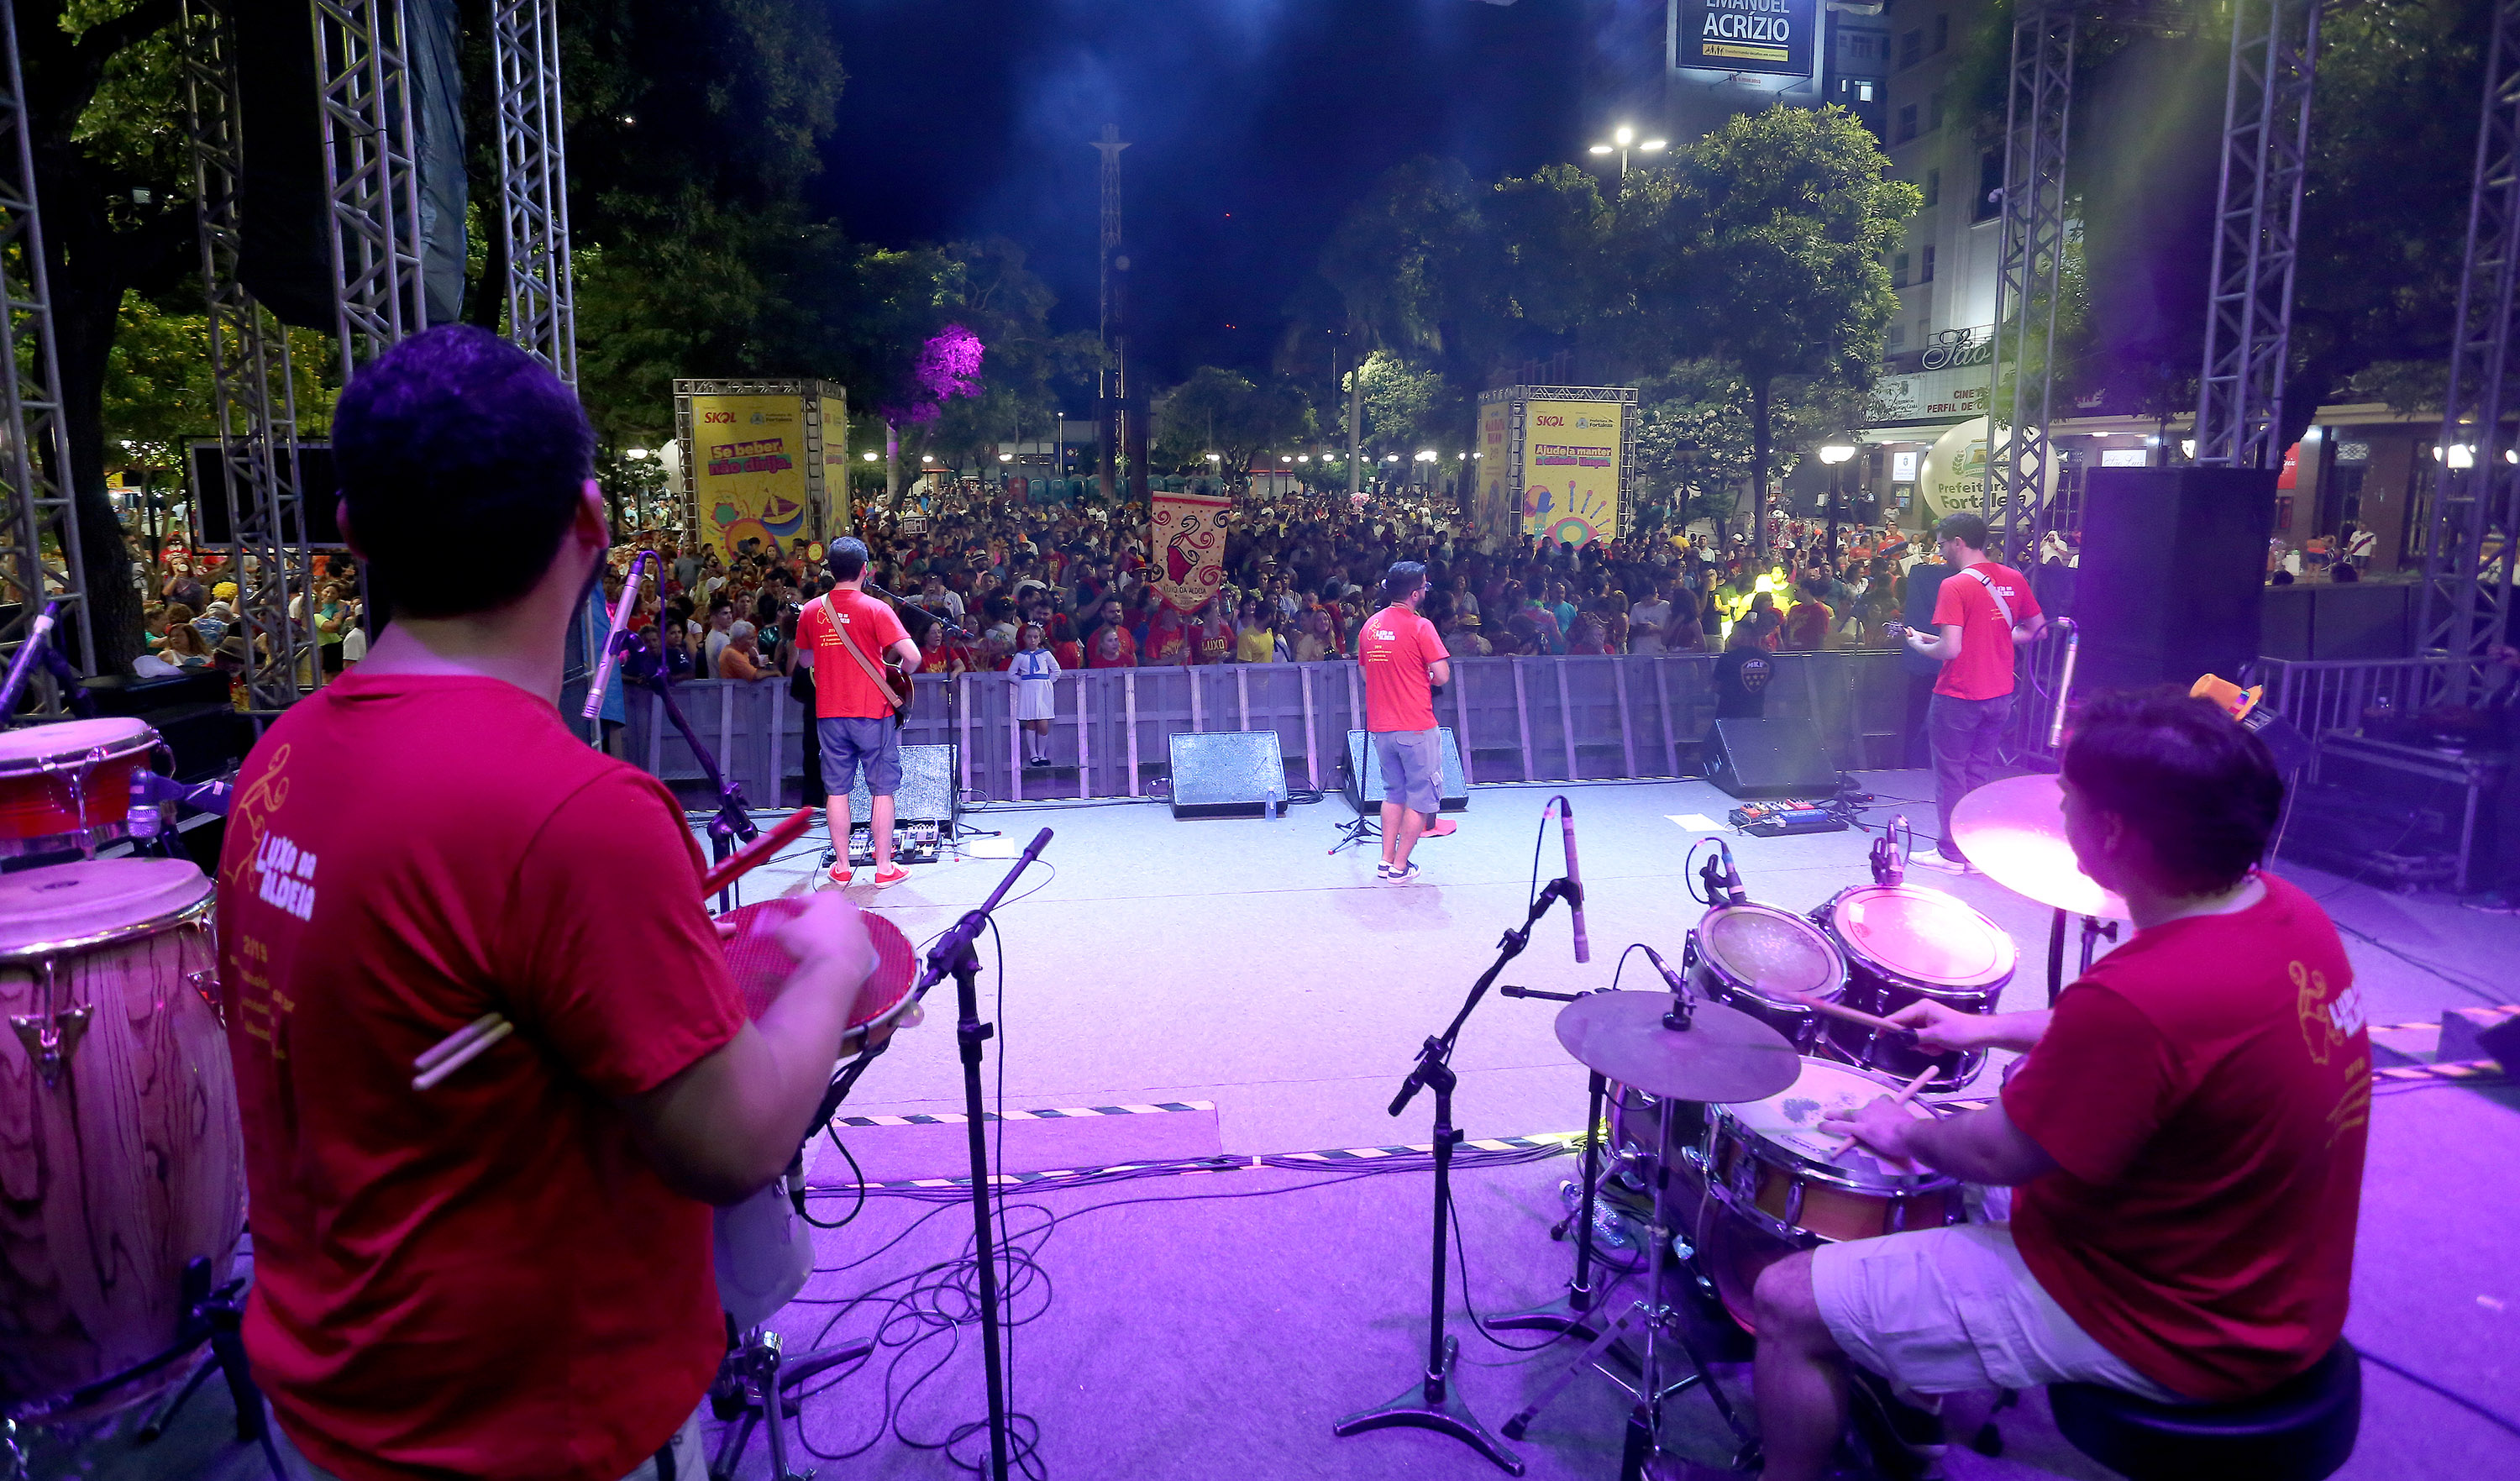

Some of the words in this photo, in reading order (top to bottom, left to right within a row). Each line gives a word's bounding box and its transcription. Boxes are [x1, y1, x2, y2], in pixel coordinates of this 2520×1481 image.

[1703, 11, 1790, 42] ACRÍZIO
[1921, 328, 1992, 370] São
[1954, 389, 1975, 400] CINE
[1927, 403, 1957, 413] PERFIL
[1961, 402, 1973, 412] DE
[704, 412, 737, 424] SKOL
[1536, 415, 1565, 428] SKOL
[712, 447, 732, 459] Se
[734, 440, 784, 454] beber,
[1536, 445, 1566, 456] Ajude
[1577, 447, 1612, 456] manter
[709, 459, 741, 475] não
[743, 455, 793, 474] dirija.
[1544, 456, 1578, 465] cidade
[1578, 456, 1611, 470] limpa.
[1940, 492, 2027, 509] Fortlea
[1201, 638, 1225, 651] LUXO
[255, 830, 297, 874] LUXO
